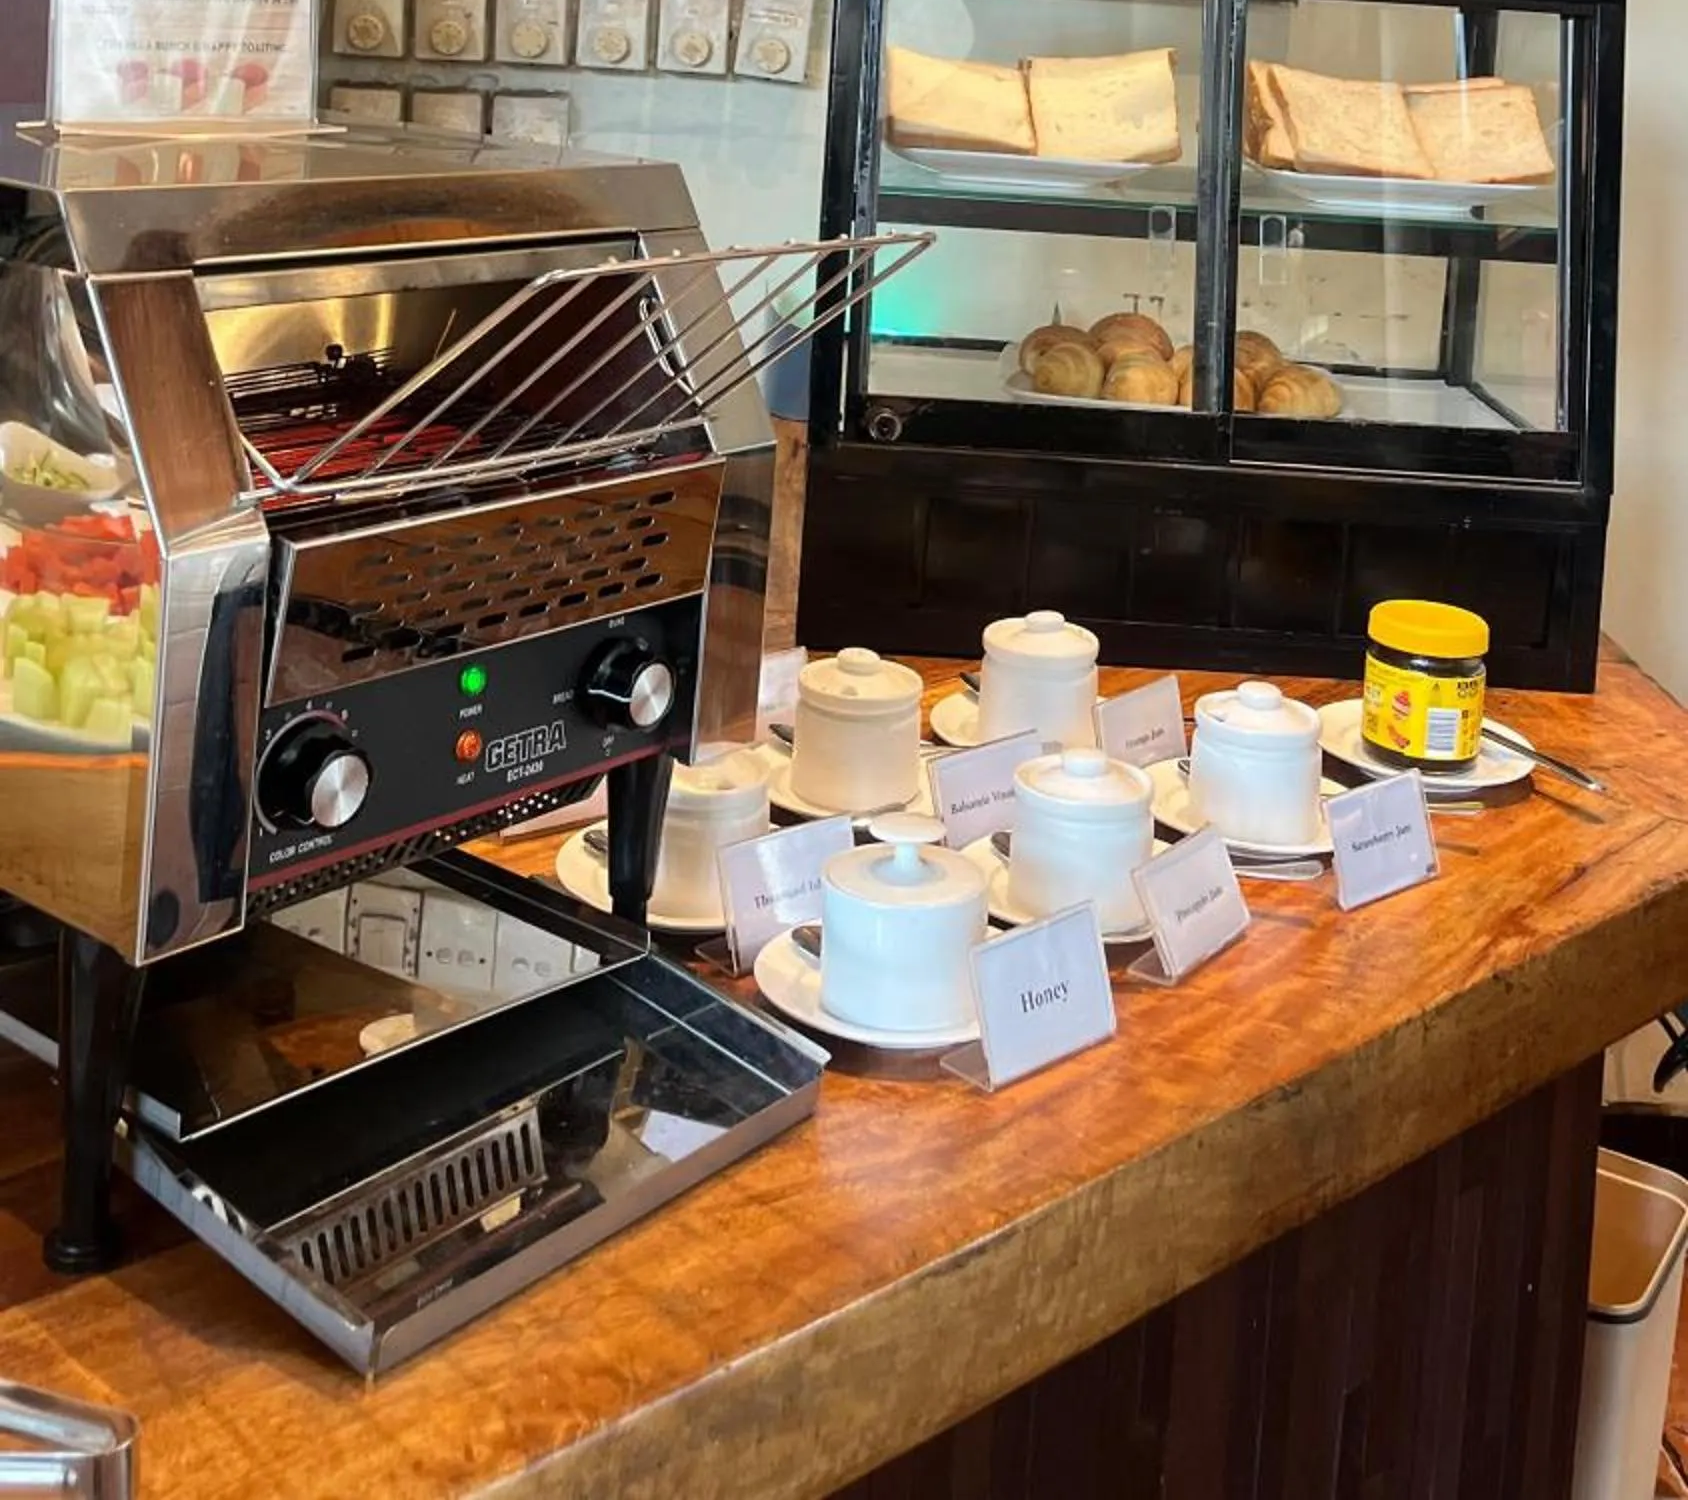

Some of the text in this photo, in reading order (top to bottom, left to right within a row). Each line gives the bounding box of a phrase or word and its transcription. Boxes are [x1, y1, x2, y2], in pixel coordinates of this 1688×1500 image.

[484, 718, 567, 773] GETRA
[269, 845, 297, 865] COLOR
[1020, 979, 1071, 1013] Honey
